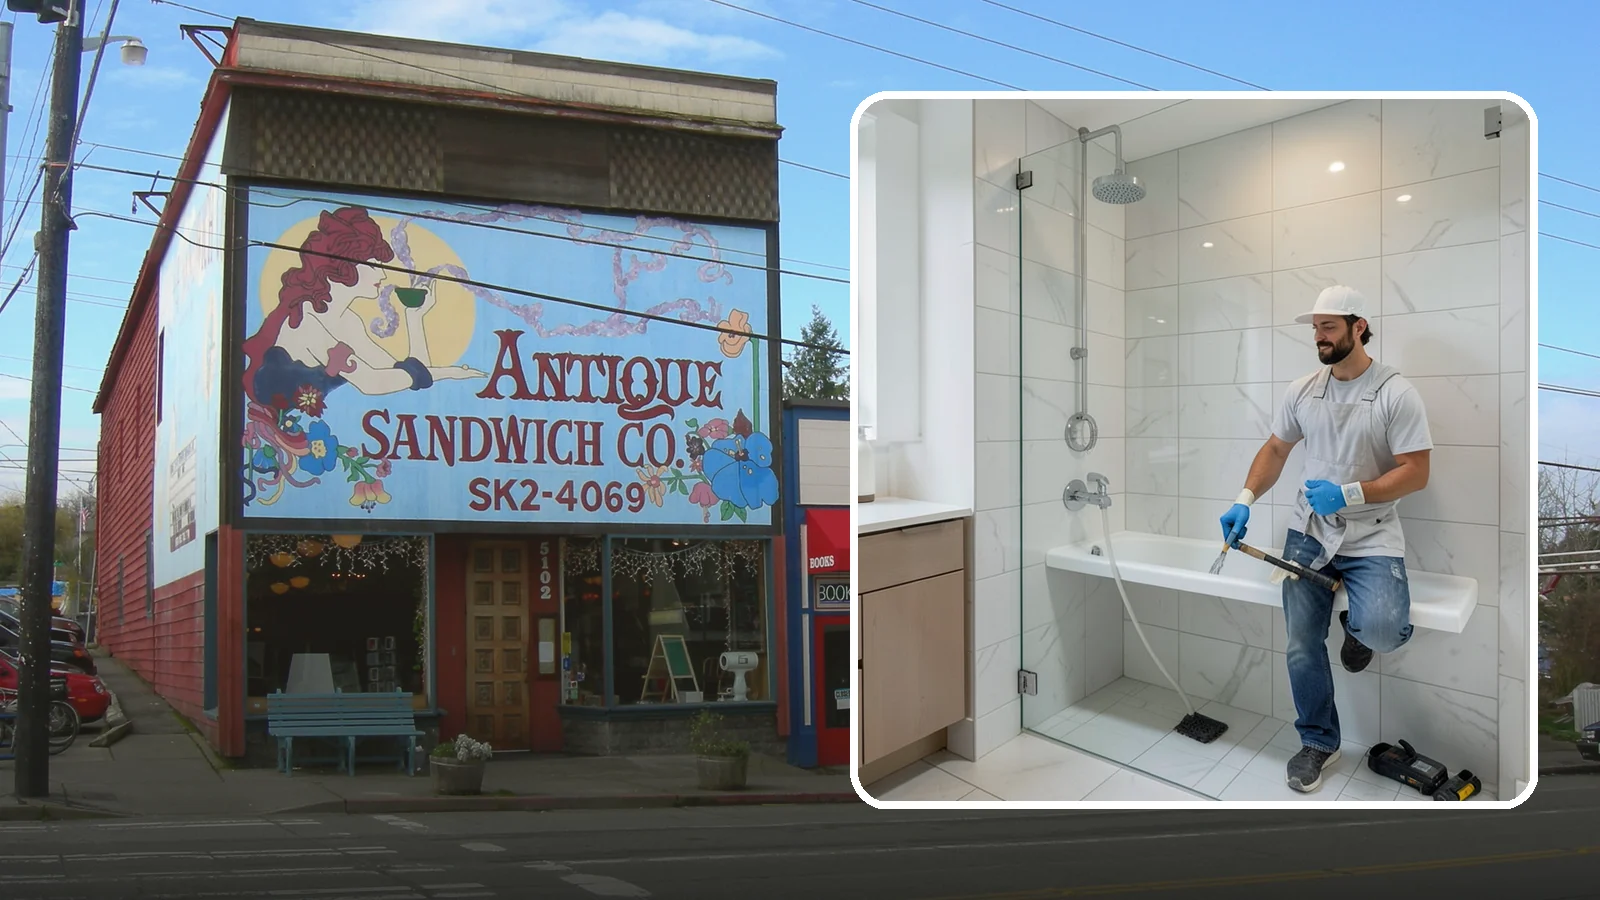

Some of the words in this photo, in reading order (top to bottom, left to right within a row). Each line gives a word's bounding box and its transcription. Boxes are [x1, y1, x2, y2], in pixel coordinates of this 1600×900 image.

[361, 408, 603, 467] SANDWICH
[617, 422, 685, 468] CO.
[469, 477, 645, 513] SK2-4069
[539, 542, 551, 599] 5102
[809, 555, 835, 569] BOOKS
